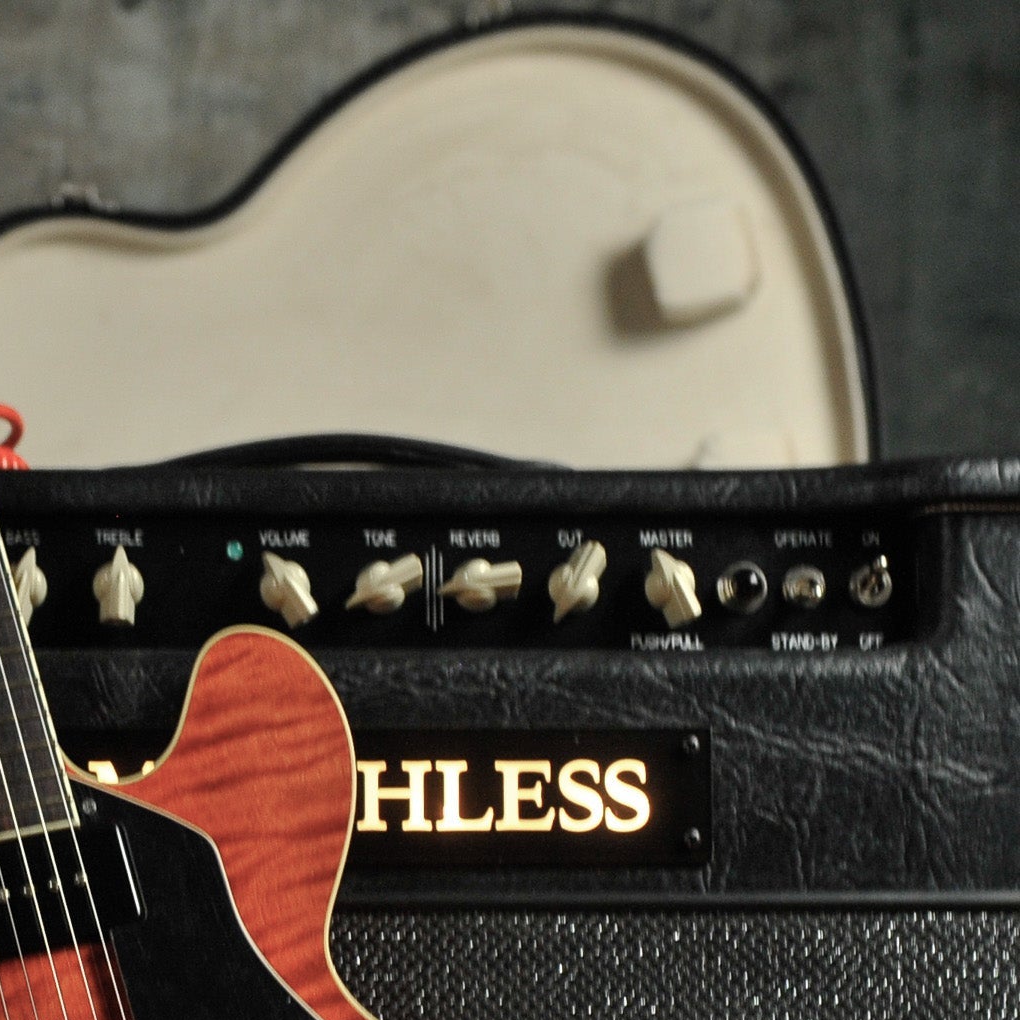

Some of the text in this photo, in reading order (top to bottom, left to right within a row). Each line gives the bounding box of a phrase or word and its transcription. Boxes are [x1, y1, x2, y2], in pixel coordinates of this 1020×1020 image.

[5, 529, 40, 546] BASS
[95, 528, 143, 547] TREBLE
[259, 528, 310, 547] VOLUME
[363, 528, 396, 547] TONE
[449, 528, 500, 547] REVERB
[558, 529, 584, 547] CUT
[639, 528, 693, 547] MASTER
[774, 529, 832, 548] OPERATE
[862, 530, 880, 546] ON
[631, 632, 703, 651] PUSH/PULL
[771, 632, 838, 651] STAND-BY
[859, 632, 884, 651] OFF
[88, 758, 651, 834] HLESS
